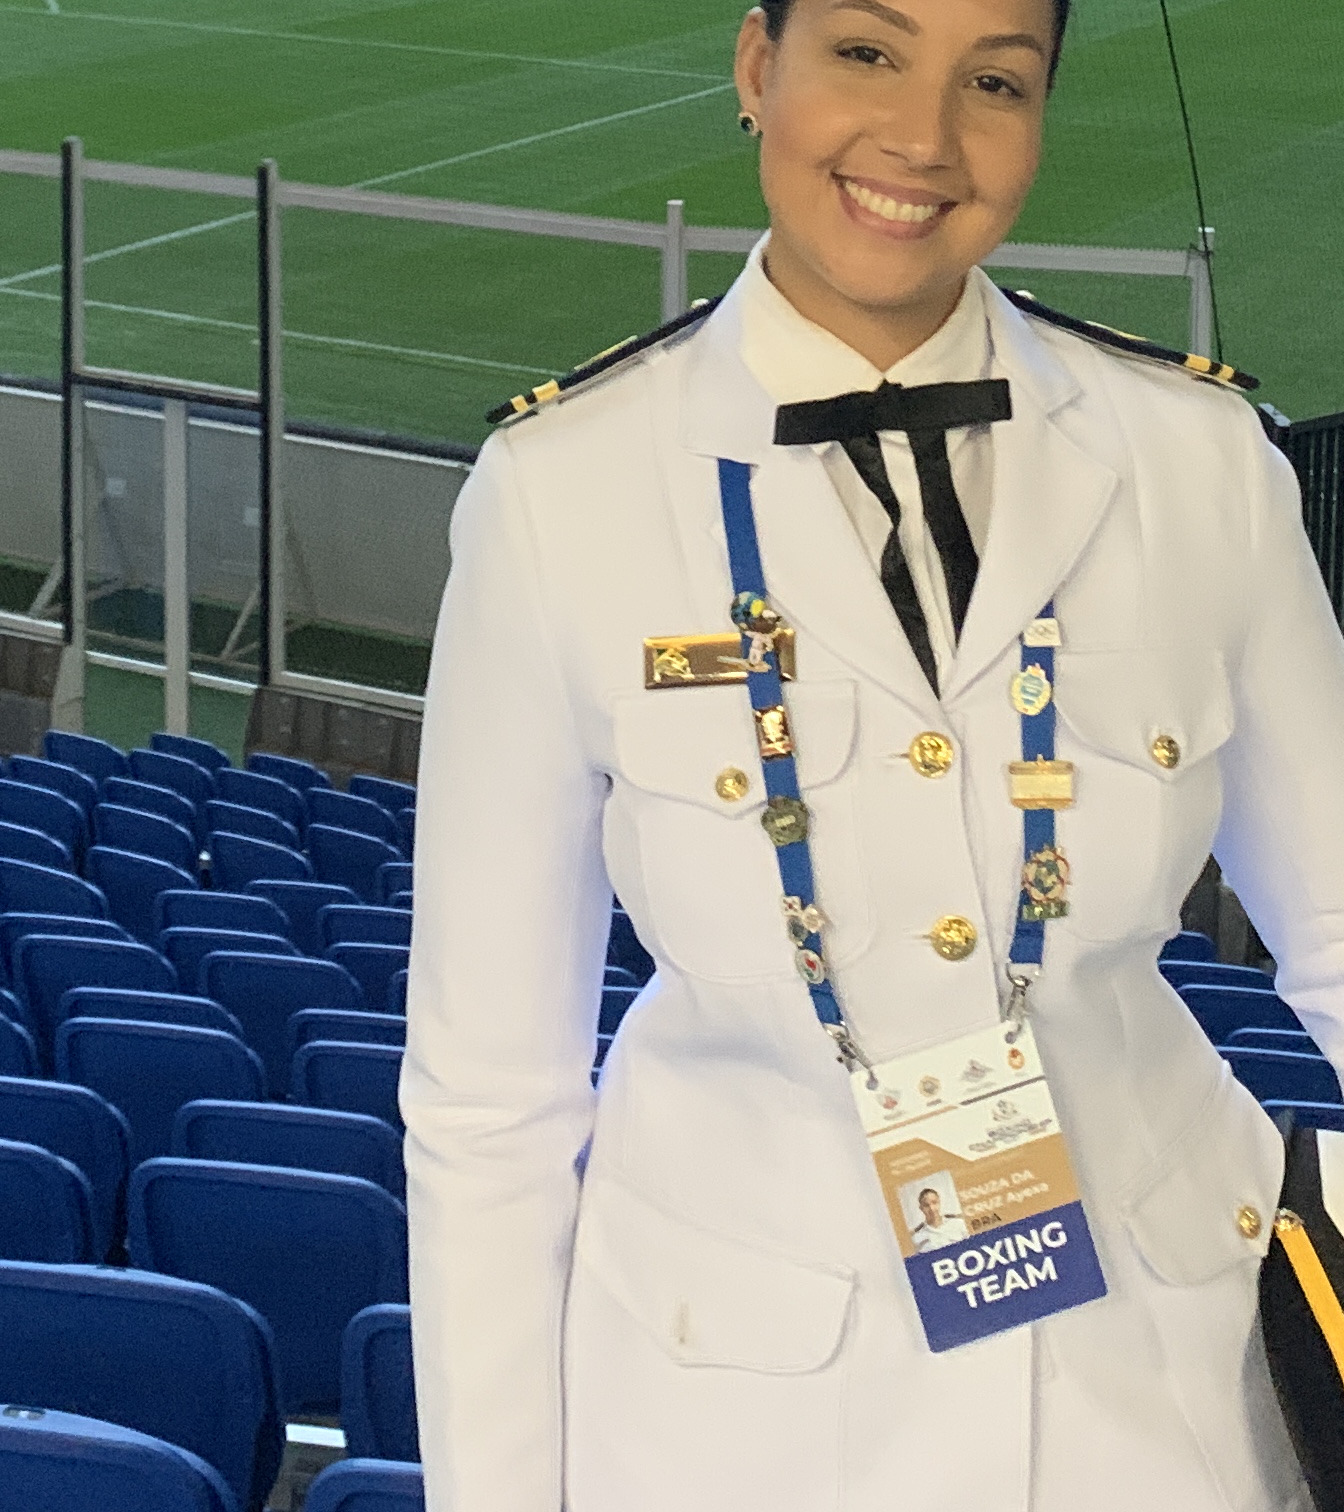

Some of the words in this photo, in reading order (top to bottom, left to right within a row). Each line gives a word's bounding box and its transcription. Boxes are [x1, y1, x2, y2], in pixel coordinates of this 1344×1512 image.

[971, 1212, 1002, 1231] BRA
[931, 1221, 1068, 1287] BOXING
[957, 1255, 1059, 1309] TEAM
